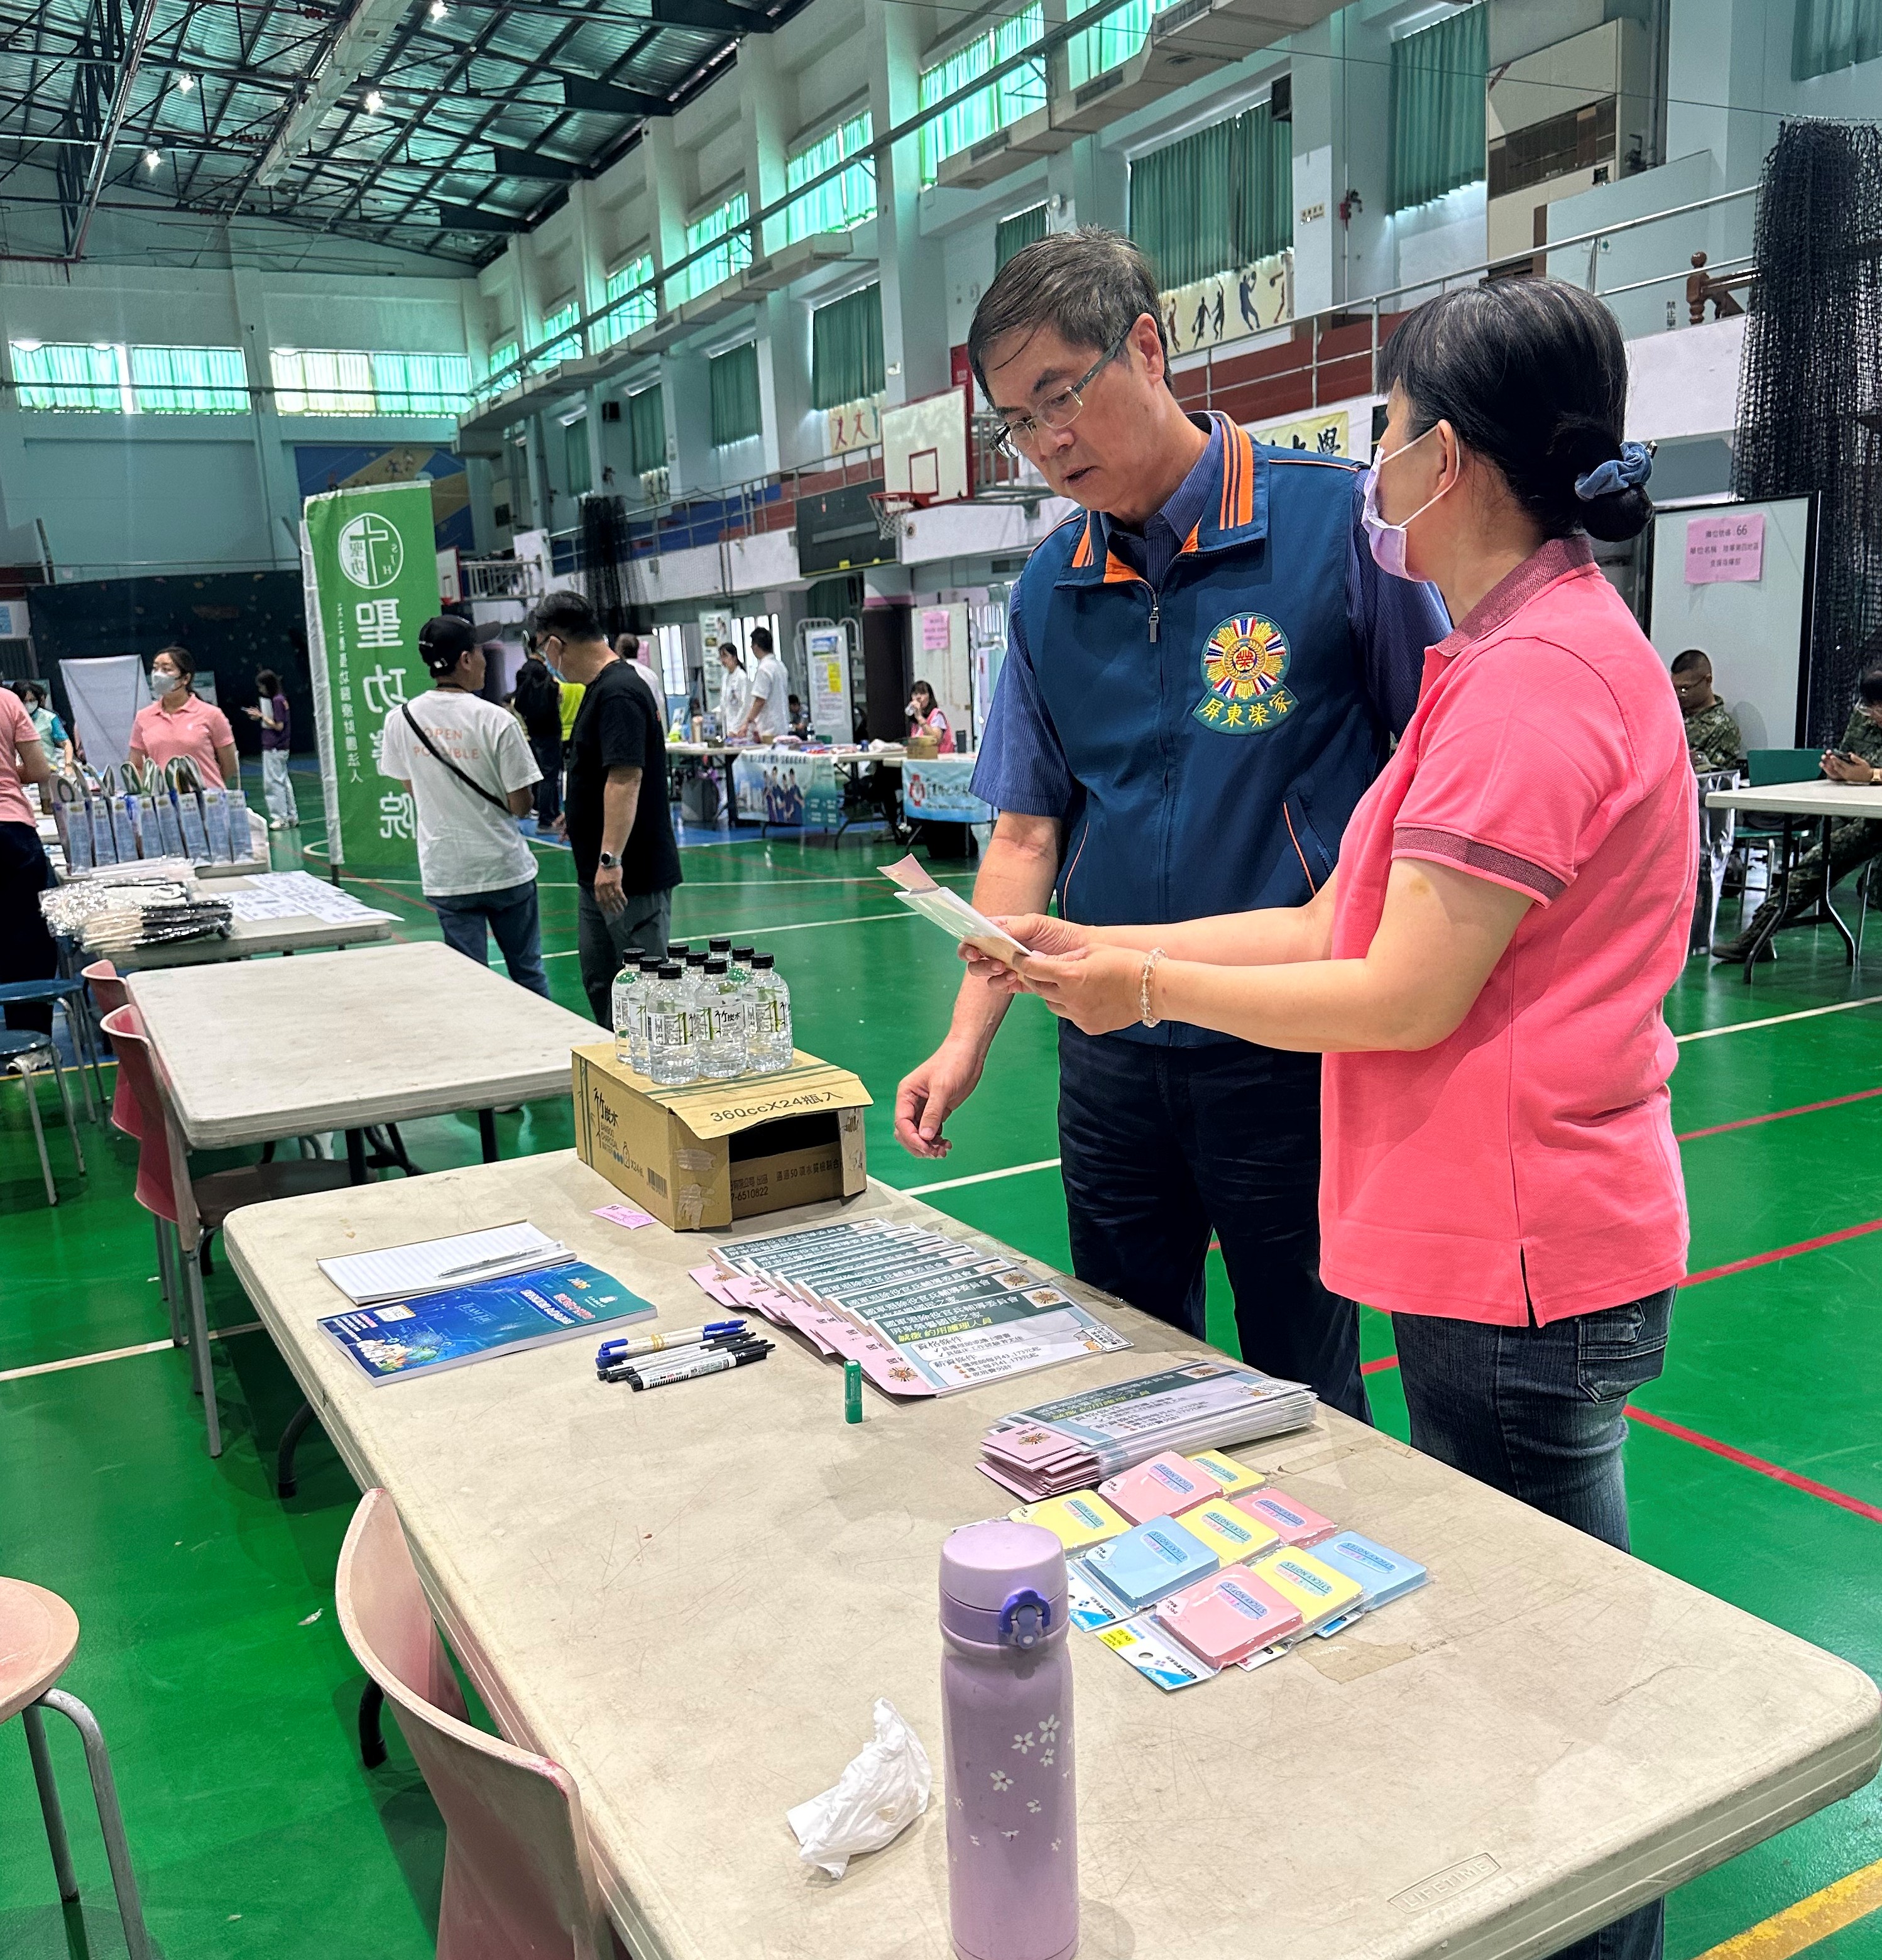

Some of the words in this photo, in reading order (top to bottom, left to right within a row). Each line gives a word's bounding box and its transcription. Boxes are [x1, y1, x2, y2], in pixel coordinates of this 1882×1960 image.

[1736, 524, 1748, 535] 66
[1200, 690, 1293, 728] 屏東榮家
[413, 746, 478, 759] POBLE
[882, 1295, 1019, 1328] 國軍退除役官兵輔導委員會
[889, 1311, 984, 1335] 屏東榮譽國民之家
[1210, 1512, 1230, 1527] NOTES
[1152, 1531, 1169, 1545] NOTES
[1229, 1523, 1251, 1539] STICKY
[1168, 1544, 1188, 1560] STICKY
[1346, 1542, 1369, 1555] NOTES
[1285, 1562, 1306, 1576] NOTES
[1369, 1553, 1394, 1570] STICKY
[1306, 1574, 1332, 1591] STICKY
[1225, 1583, 1247, 1601] NOTES
[1246, 1598, 1267, 1614] STICKY
[1403, 1860, 1490, 1908] LIFETIME
